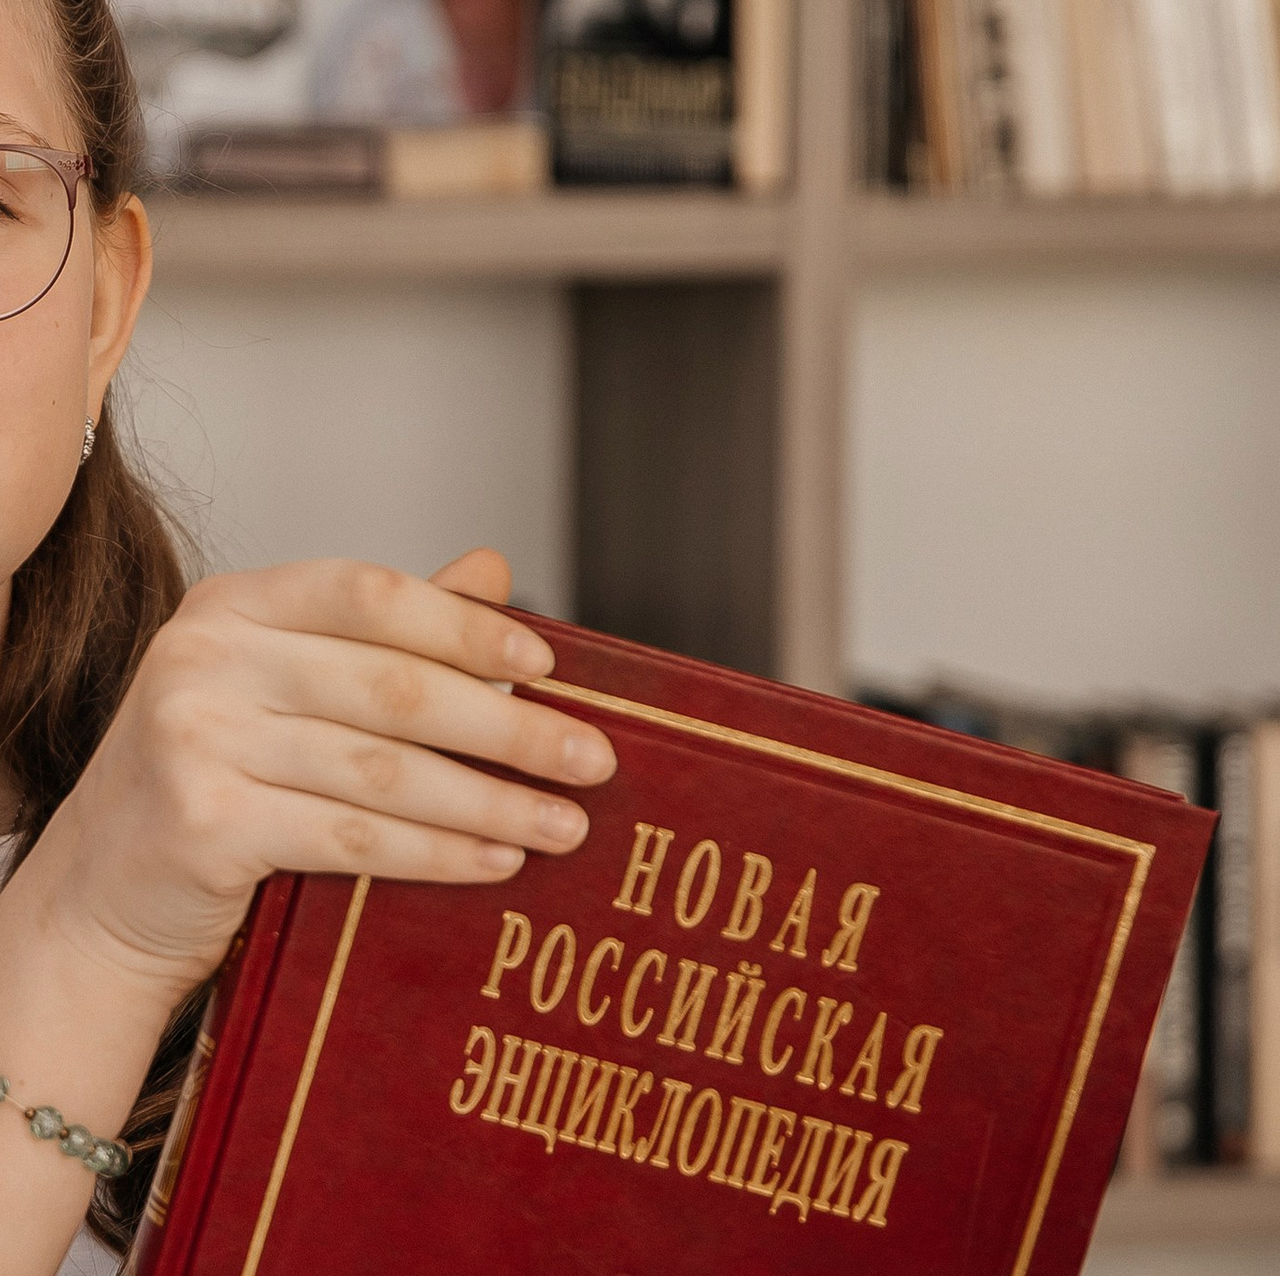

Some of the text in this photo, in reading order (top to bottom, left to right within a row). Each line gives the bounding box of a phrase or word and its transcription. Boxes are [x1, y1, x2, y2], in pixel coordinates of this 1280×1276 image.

[612, 822, 880, 972] НОВАЯ
[481, 910, 943, 1113] РОССИЙСКАЯ
[450, 1026, 908, 1227] ЭНЦИКЛОПЕДИЯ
